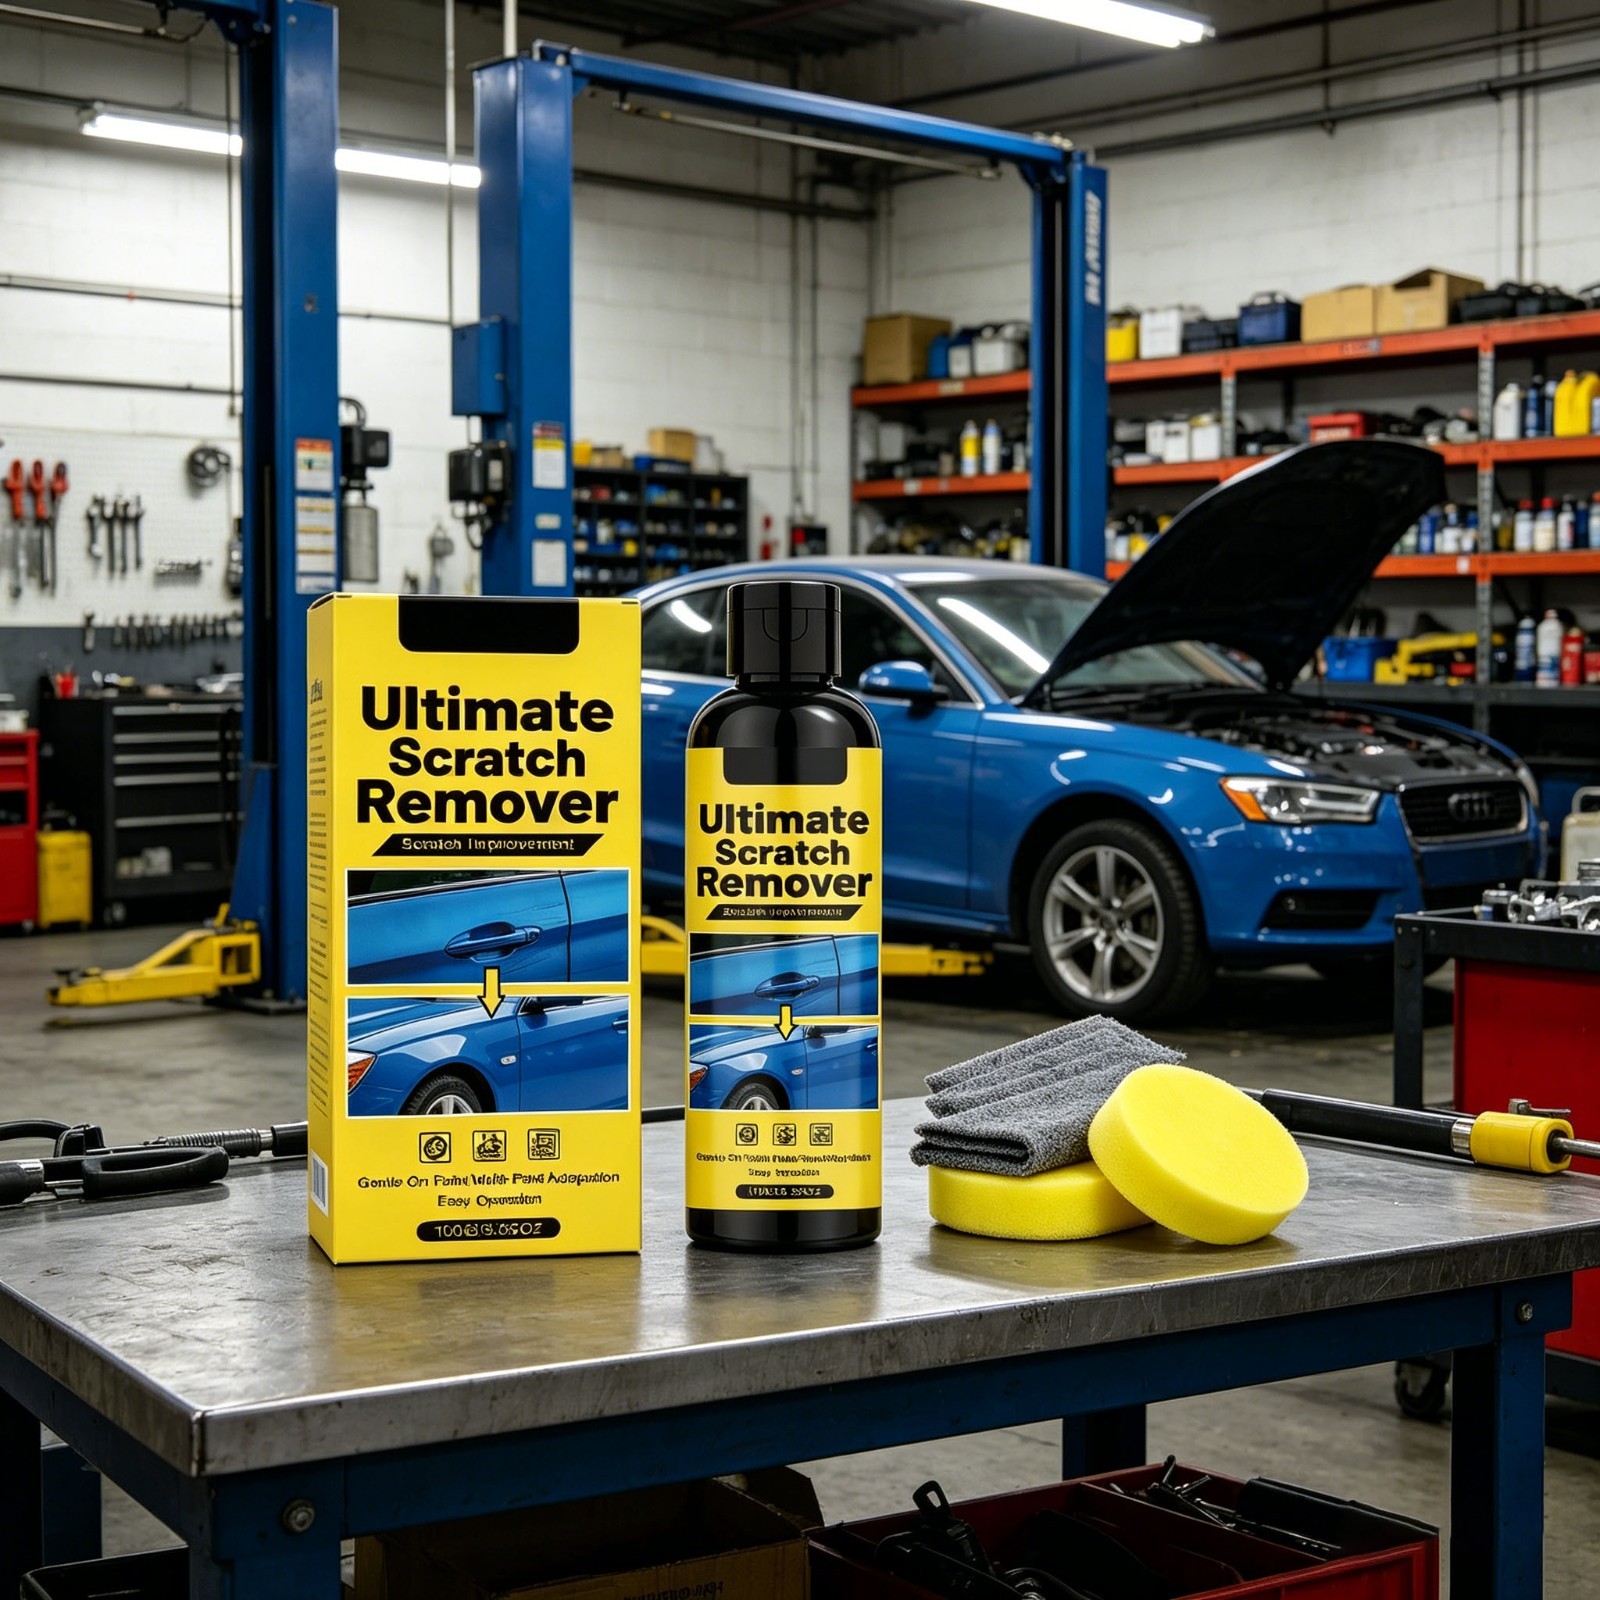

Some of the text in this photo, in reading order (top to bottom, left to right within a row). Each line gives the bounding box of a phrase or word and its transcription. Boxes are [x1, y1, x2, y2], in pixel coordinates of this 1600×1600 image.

[361, 685, 614, 733] Ultimate
[388, 736, 586, 778] Scratch
[357, 778, 619, 824] Remover
[699, 802, 870, 835] Ultimate
[715, 838, 850, 866] Scratch
[696, 866, 873, 898] Remover
